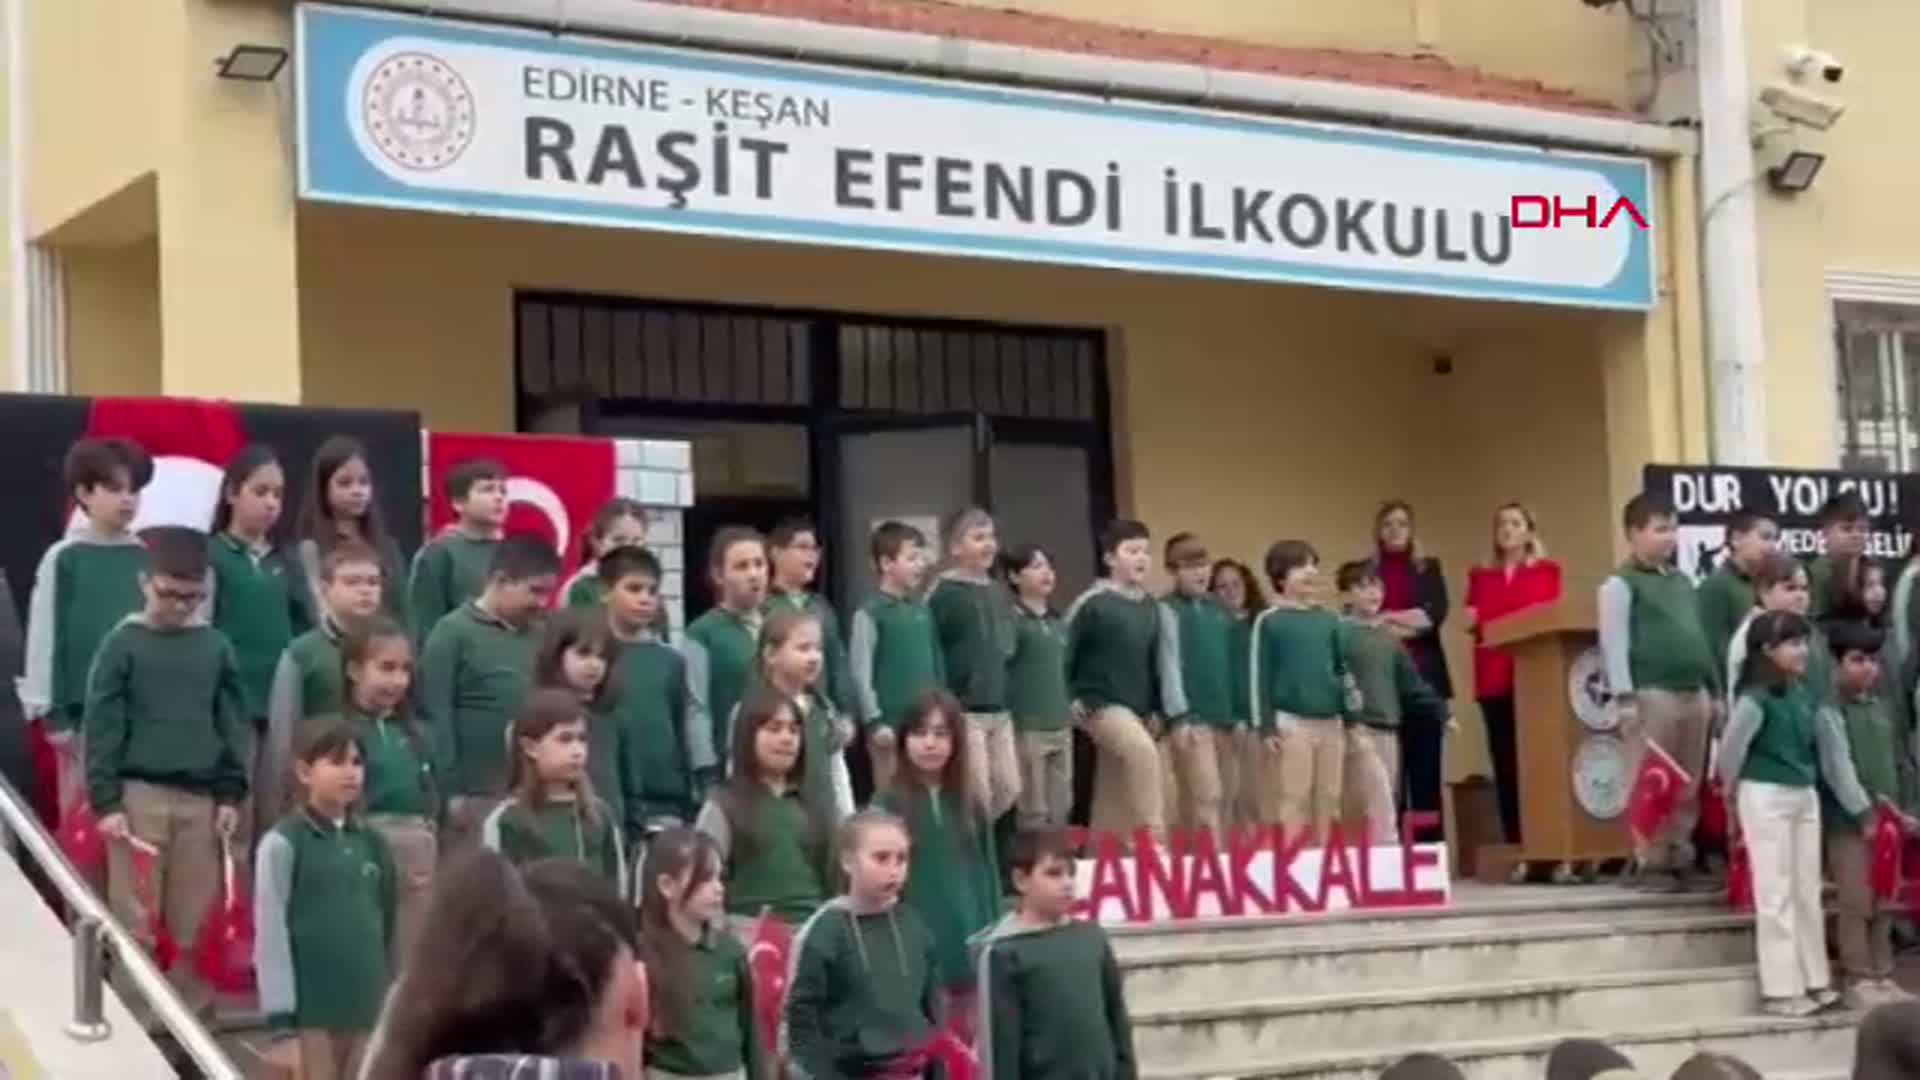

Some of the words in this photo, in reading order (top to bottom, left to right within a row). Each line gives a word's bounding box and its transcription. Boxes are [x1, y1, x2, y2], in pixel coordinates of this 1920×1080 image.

[523, 65, 670, 112] EDİRNE
[705, 86, 831, 130] KEŞAN
[524, 114, 790, 211] RAŞİT
[833, 146, 1122, 232] EFENDİ
[1164, 166, 1513, 266] İLKOKULU
[1671, 472, 1744, 514] DUR
